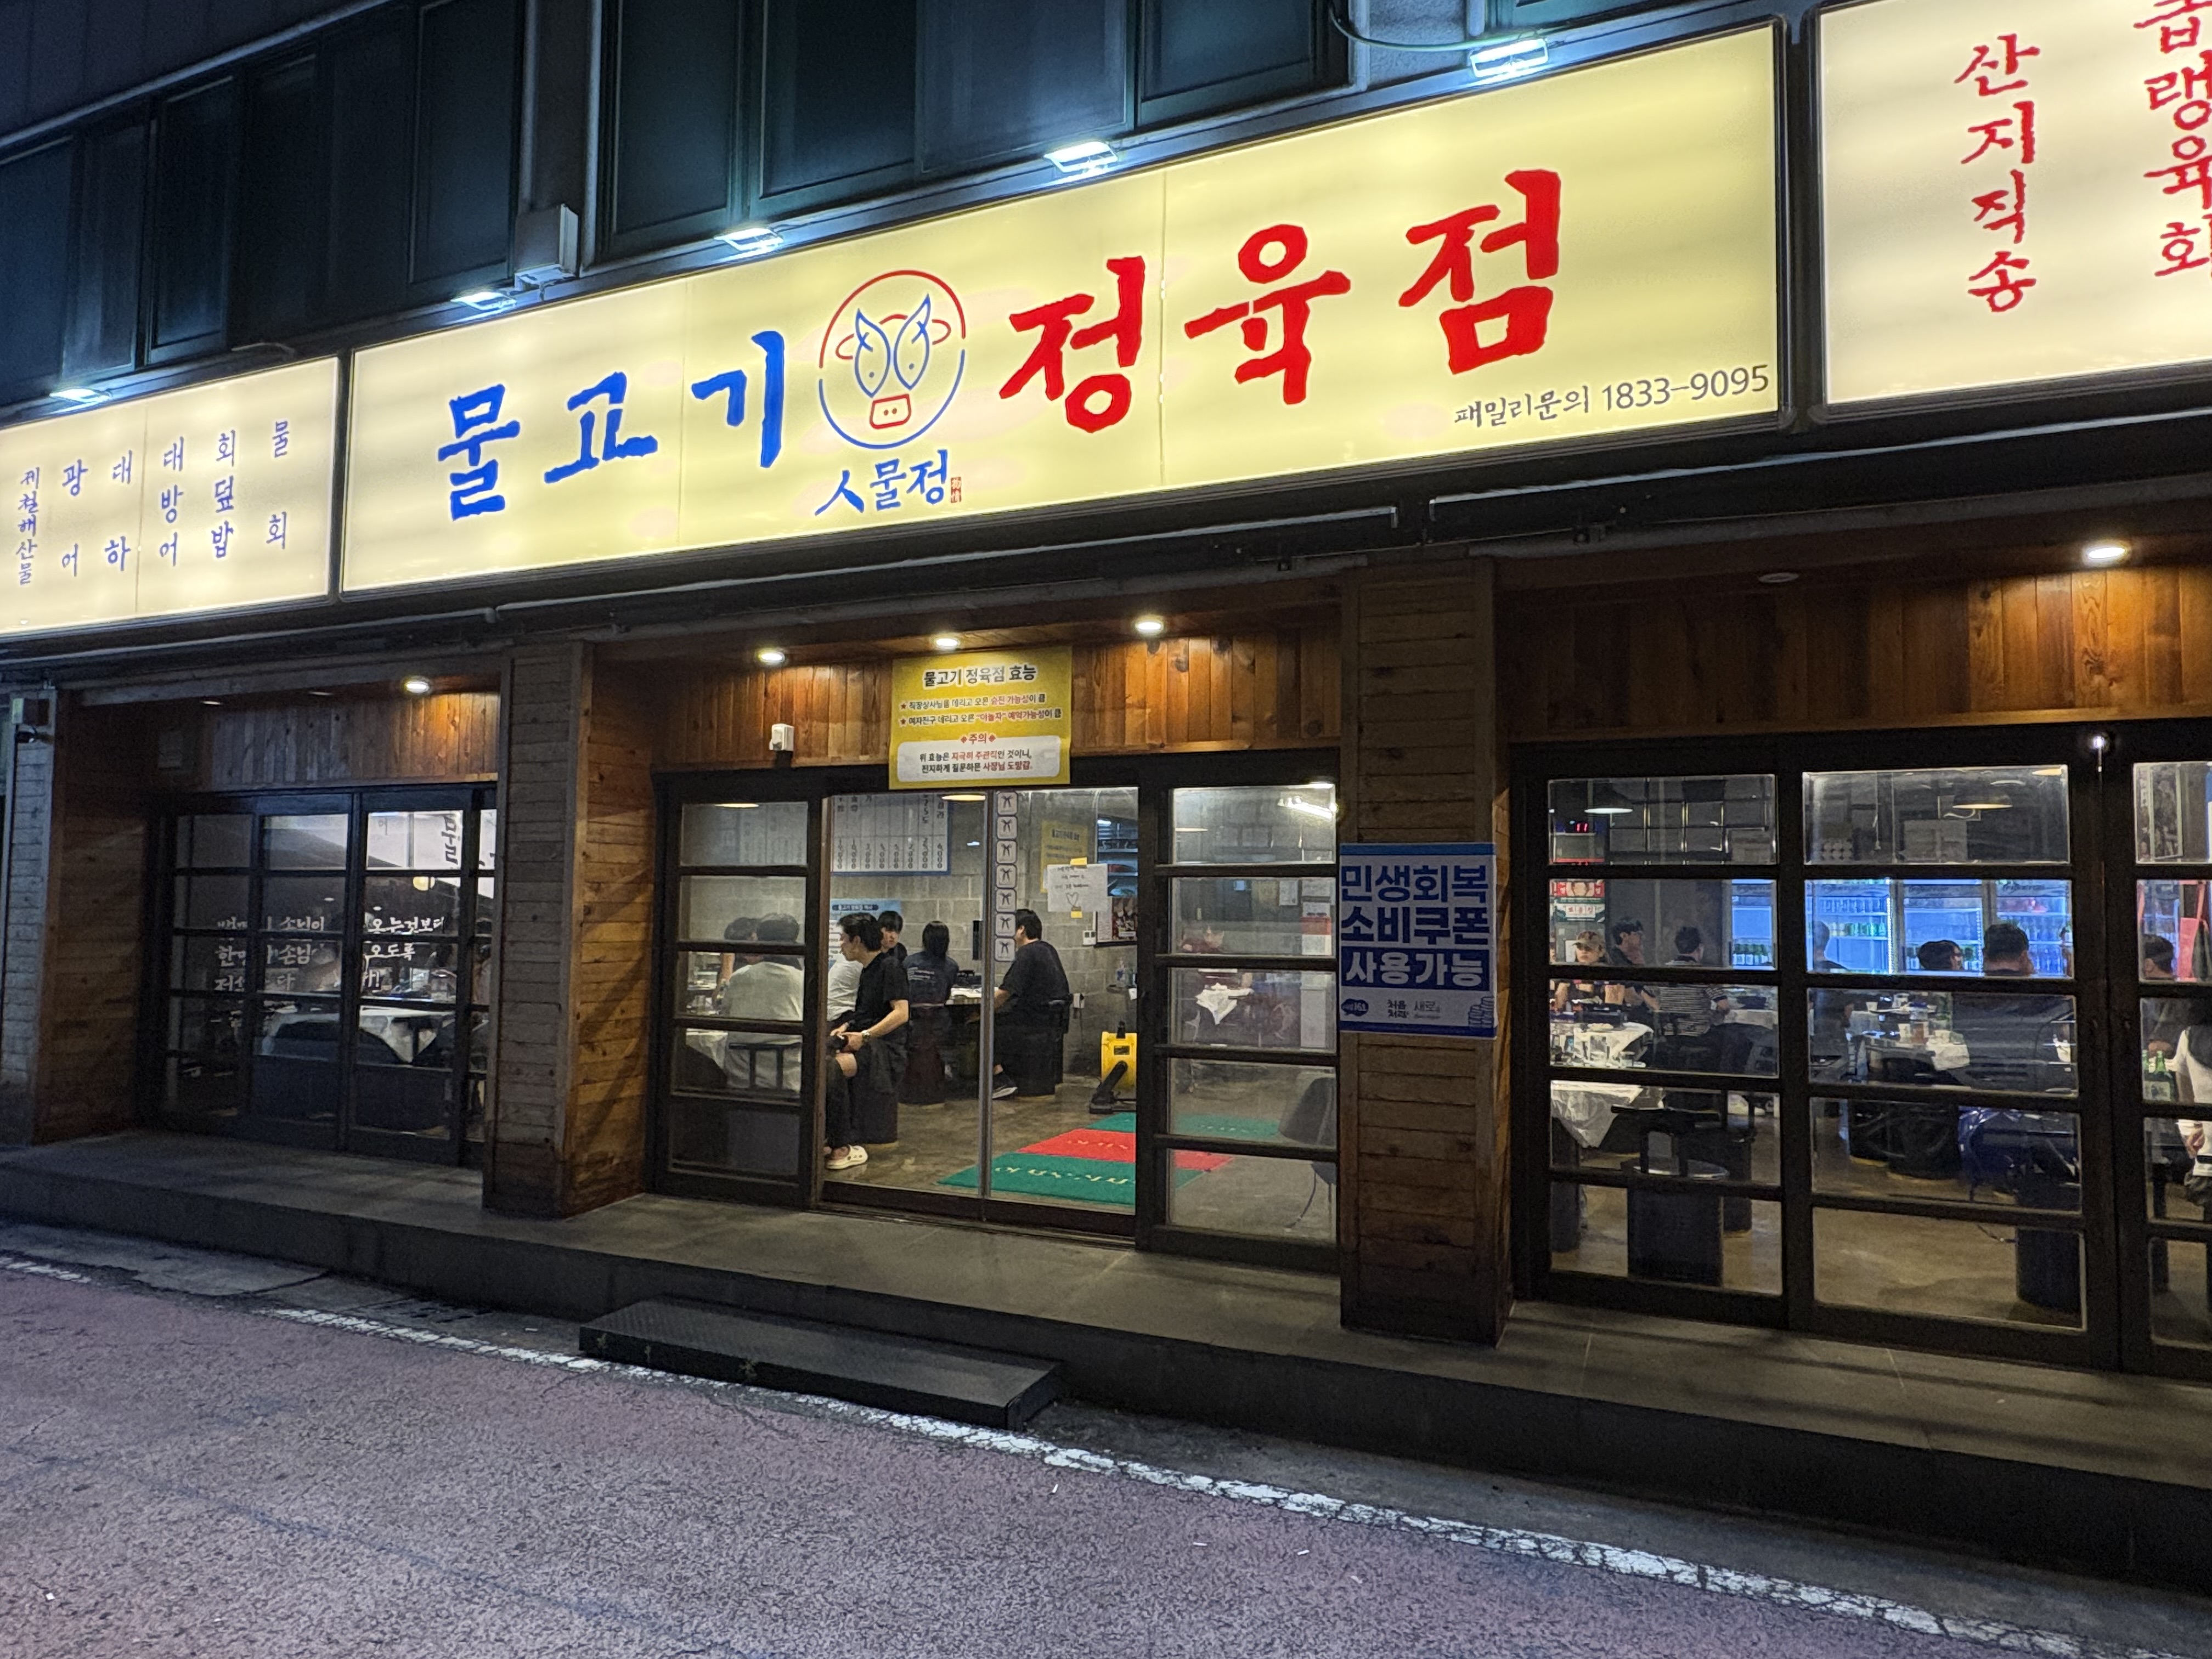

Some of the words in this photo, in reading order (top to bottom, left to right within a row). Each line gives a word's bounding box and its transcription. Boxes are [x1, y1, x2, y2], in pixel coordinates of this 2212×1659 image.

[1954, 33, 2040, 312] 산지직송
[438, 330, 785, 520] 물고기
[999, 169, 1562, 433] 정육점
[1455, 385, 1589, 427] 패밀리문의
[1602, 364, 1769, 411] 1833-9095
[15, 466, 40, 585] 제철해산물
[61, 459, 88, 577] 광어
[104, 450, 133, 572] 대하
[159, 436, 184, 566] 대방어
[211, 430, 236, 558] 회덮밥
[266, 420, 290, 550] 물회
[924, 669, 962, 687] 물고기
[966, 666, 1005, 684] 정육점
[1009, 664, 1036, 681] 효능
[969, 733, 986, 745] 주의
[1341, 865, 1489, 904] 민생회복
[1341, 906, 1490, 945] 소비쿠폰
[1346, 951, 1483, 987] 사용가능
